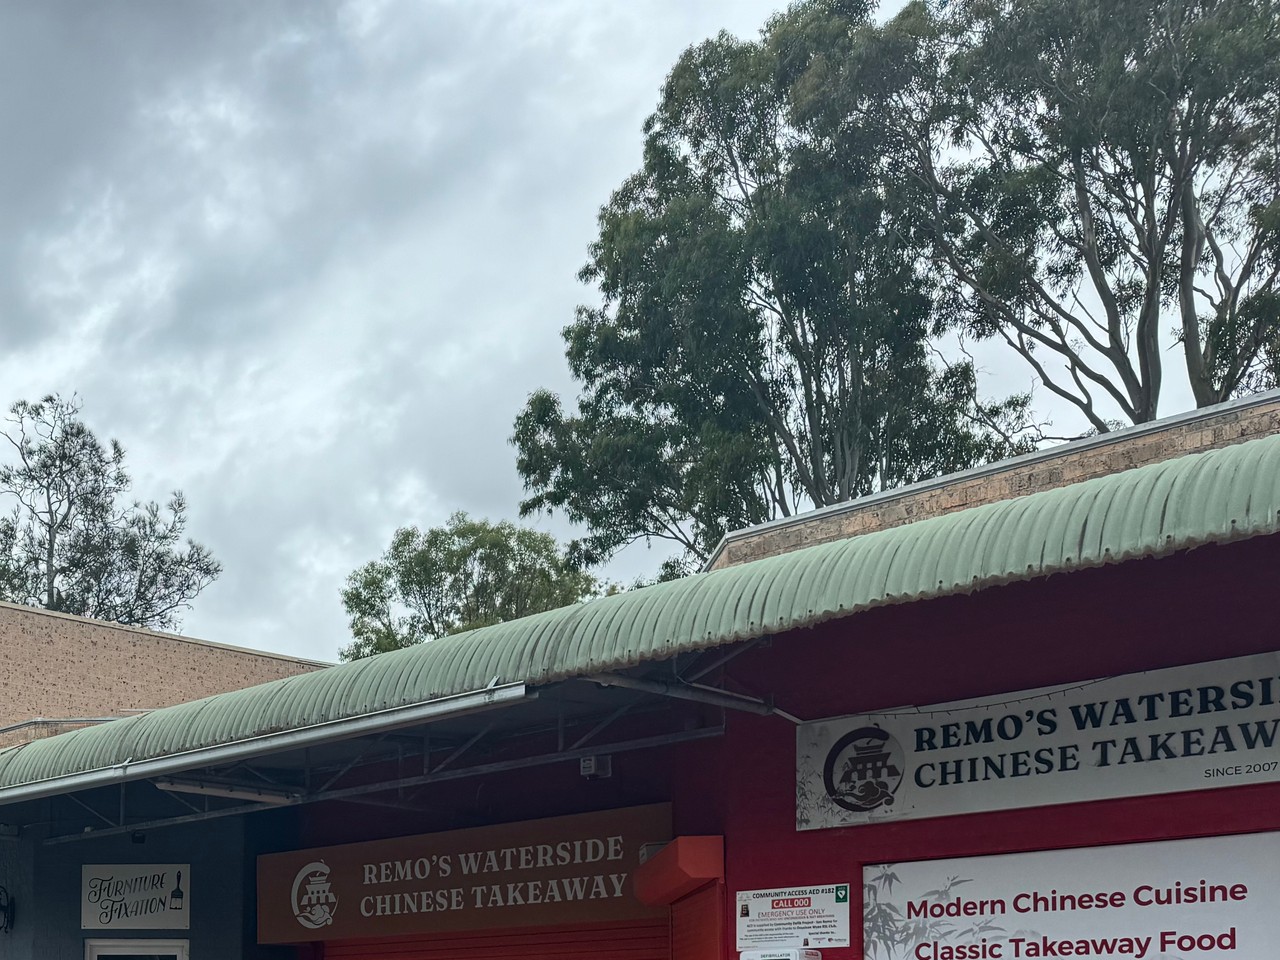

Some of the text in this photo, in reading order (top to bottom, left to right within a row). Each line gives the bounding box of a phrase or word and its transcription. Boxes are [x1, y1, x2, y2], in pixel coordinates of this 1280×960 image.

[913, 675, 1280, 752] REMO'S WATERSI
[913, 718, 1280, 788] CHINESE TAKEAW
[1204, 762, 1279, 778] SINCE 2007
[362, 836, 624, 885] REMO'S WATERSIDE
[360, 873, 628, 917] CHINESE TAKEAWAY
[752, 891, 787, 899] COMMUNITY
[787, 889, 807, 897] ACCESS
[773, 899, 809, 908] CALL 000
[906, 879, 1248, 920] Modern Chinese Cuisine
[758, 910, 795, 918] EMERGENCY
[1008, 936, 1152, 959] Takeaway
[1159, 927, 1237, 953] Food
